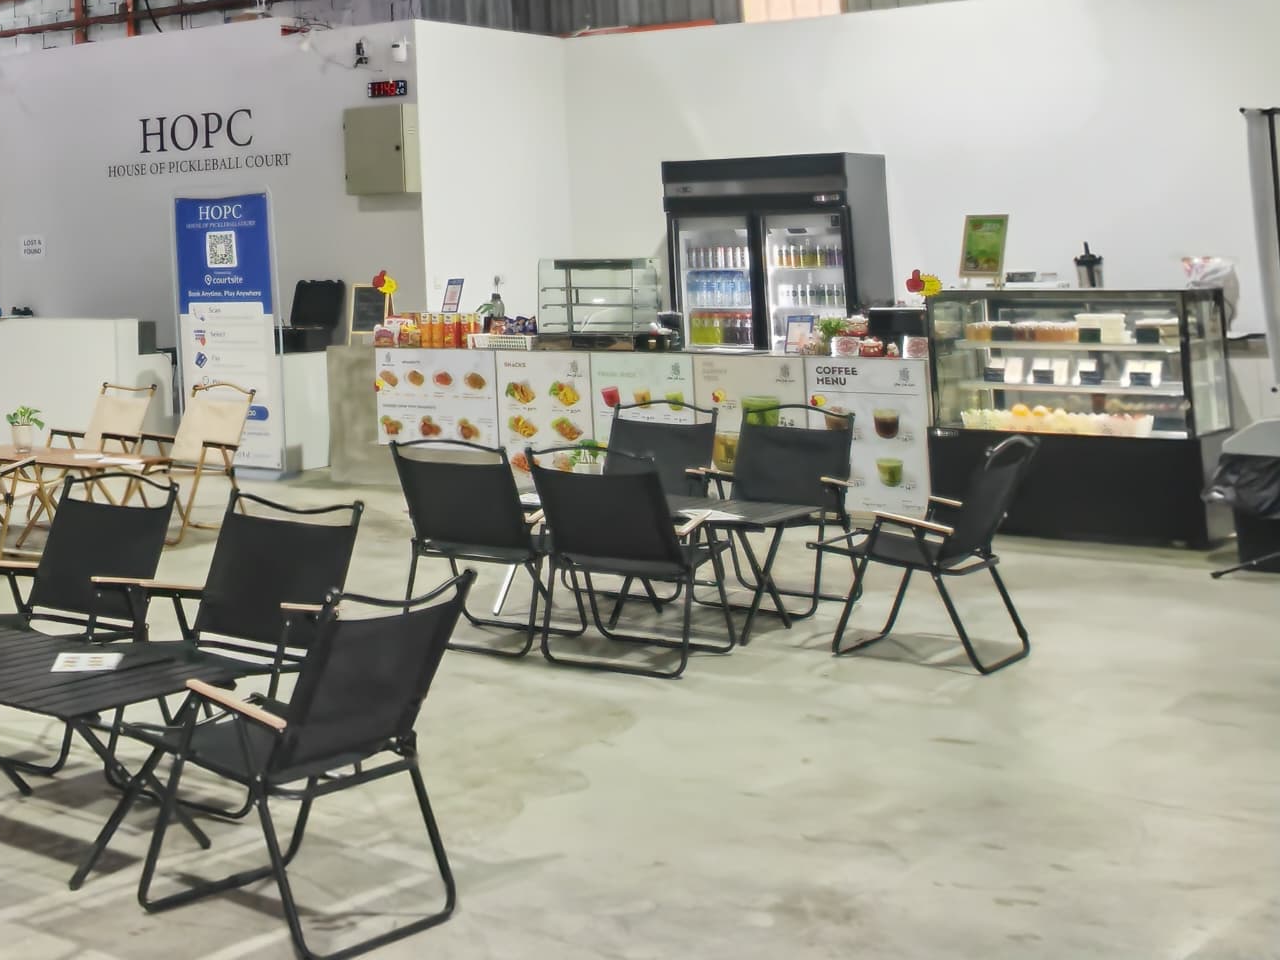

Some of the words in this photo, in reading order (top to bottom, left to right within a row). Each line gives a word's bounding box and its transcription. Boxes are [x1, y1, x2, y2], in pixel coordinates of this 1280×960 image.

[139, 108, 253, 153] HOPC
[108, 163, 147, 178] HOUSE
[149, 161, 166, 175] OF
[168, 156, 243, 174] PICKLEBALL
[245, 153, 291, 169] COURT
[198, 204, 243, 221] HOPC
[24, 247, 42, 255] FOUND
[213, 275, 244, 285] courtsite
[816, 366, 858, 376] COFFEE
[816, 376, 847, 386] MENU
